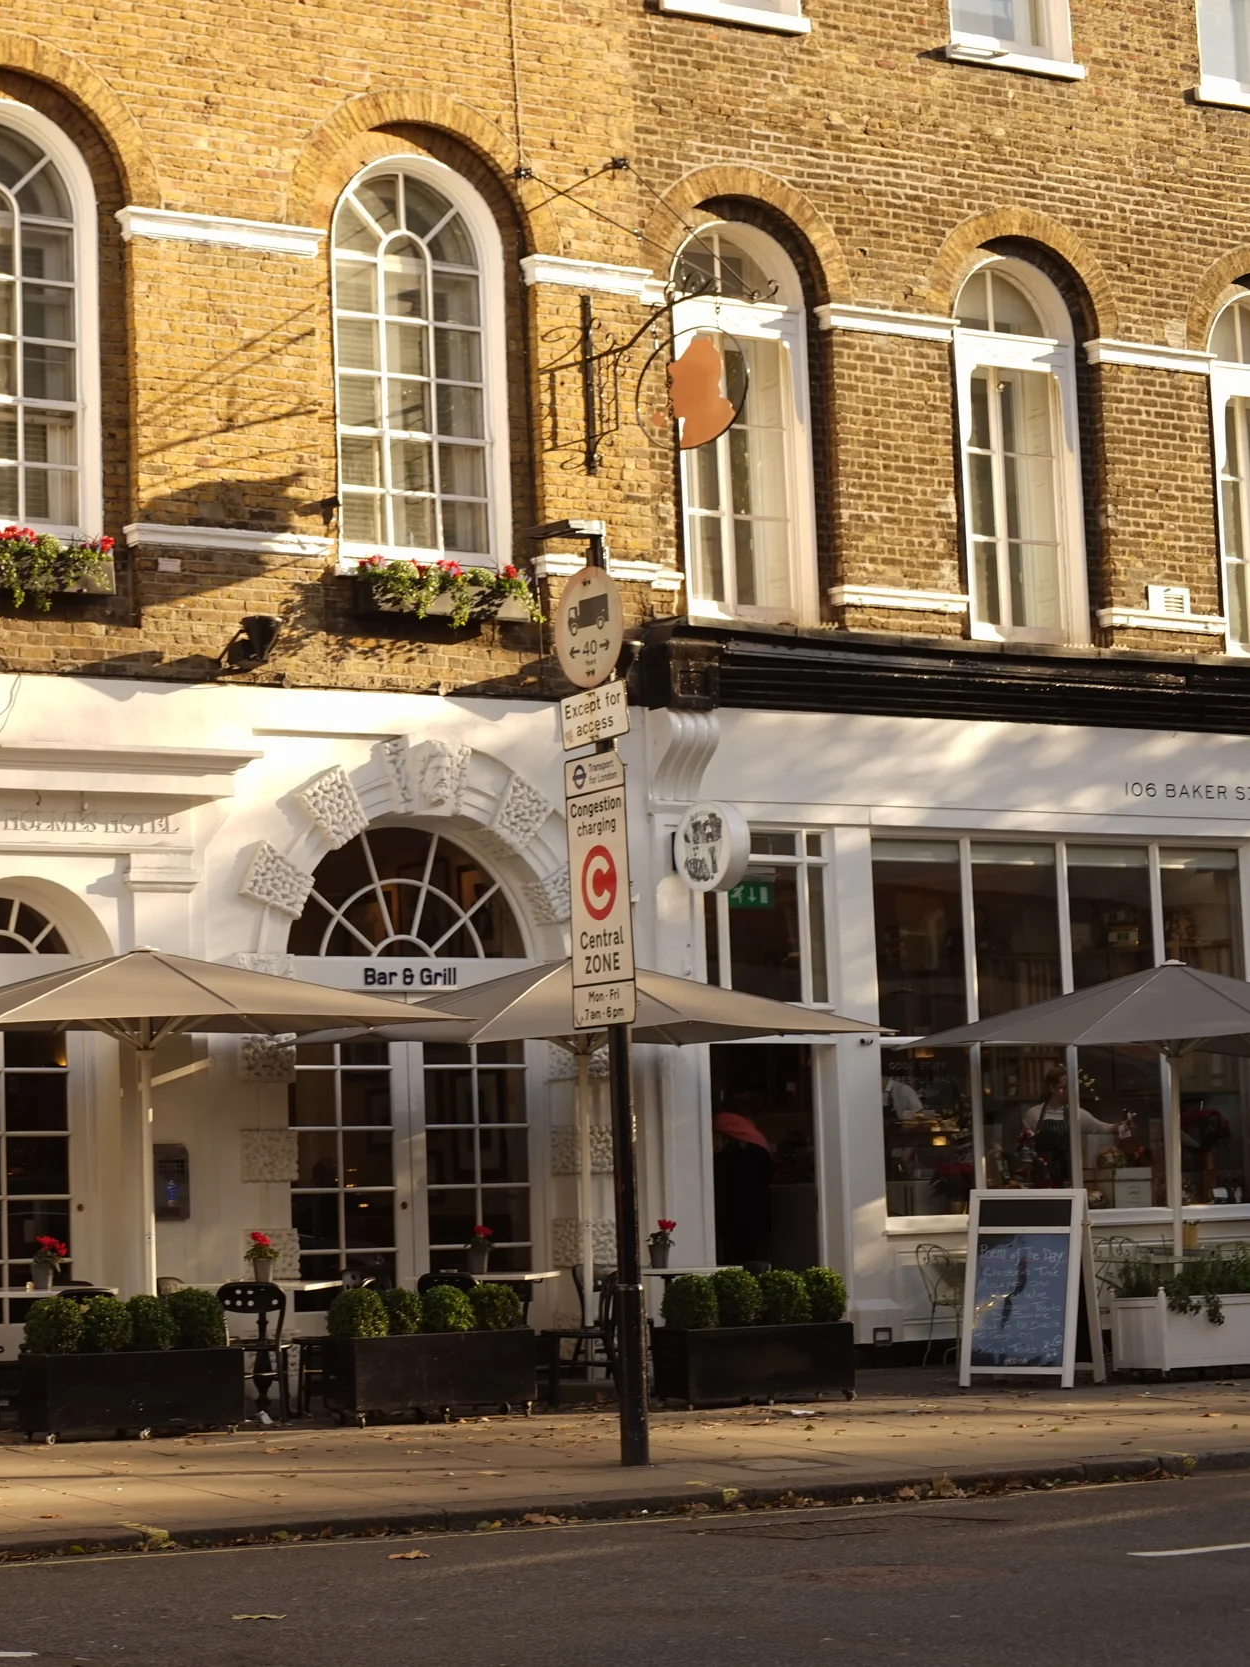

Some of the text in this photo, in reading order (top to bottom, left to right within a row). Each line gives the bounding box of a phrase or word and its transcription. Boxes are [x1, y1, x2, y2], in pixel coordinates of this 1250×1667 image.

[582, 639, 597, 656] 40
[565, 690, 621, 720] Except for
[576, 714, 614, 737] access
[588, 760, 615, 772] Transport
[589, 771, 618, 784] for London
[1125, 781, 1250, 801] 106 BAKER S
[570, 796, 621, 819] Congestion
[2, 808, 97, 833] HOLMES
[103, 811, 180, 835] HOTEL
[576, 817, 616, 837] charging
[580, 926, 624, 950] Central
[584, 951, 621, 975] ZONE
[364, 967, 457, 985] Bar & Grill
[588, 991, 604, 1003] Mon
[609, 988, 620, 1001] Fri
[1011, 1247, 1022, 1266] of
[1042, 1248, 1065, 1269] Day
